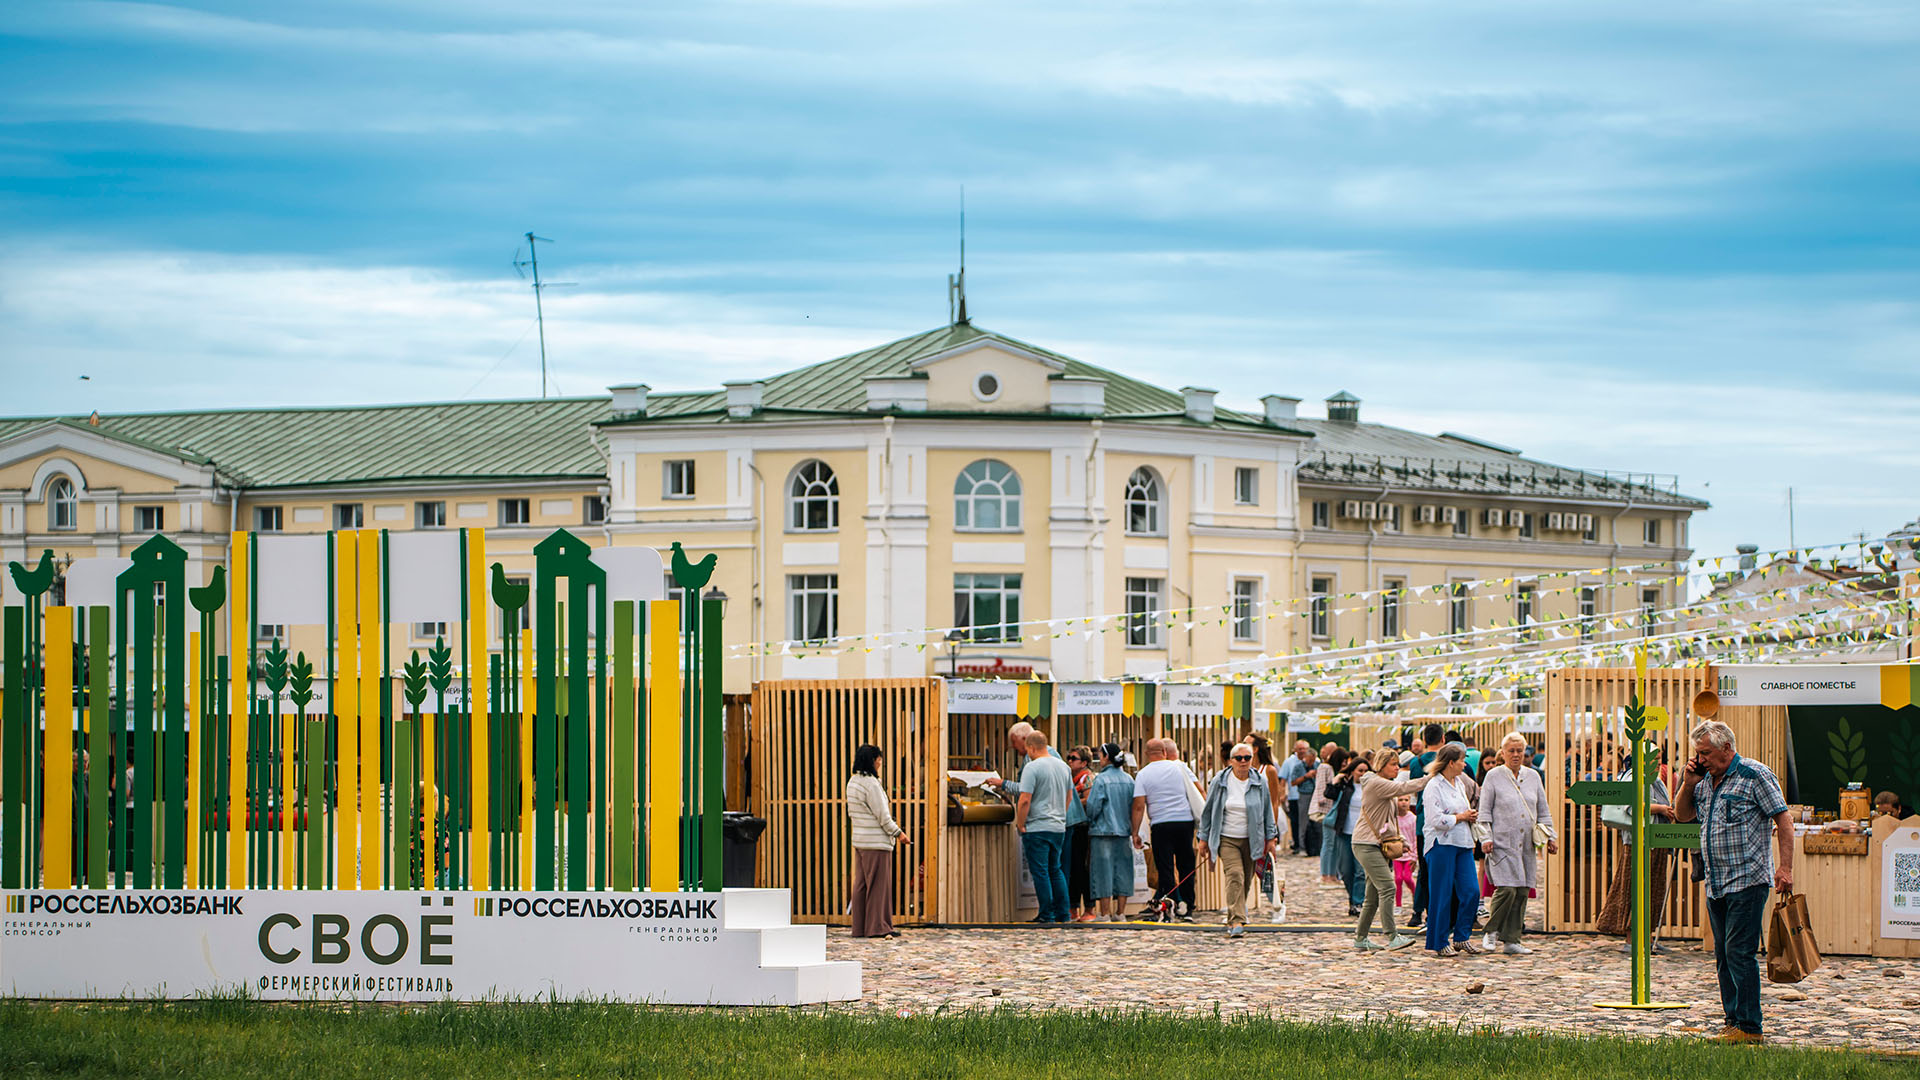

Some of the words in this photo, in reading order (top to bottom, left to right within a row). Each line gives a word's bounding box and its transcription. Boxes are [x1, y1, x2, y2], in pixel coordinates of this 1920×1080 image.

[1760, 682, 1804, 690] СЛАВНОЕ
[1806, 681, 1856, 690] ПОМЕСТЬЕ
[30, 894, 243, 915] РОССЕЛЬХОЗБАНК
[498, 898, 718, 919] РОССЕЛЬХОЗБАНК
[257, 896, 454, 966] СВОЁ
[259, 974, 361, 992] ФЕРМЕРСКИЙ
[365, 976, 453, 993] ФЕСТИВАЛЬ
